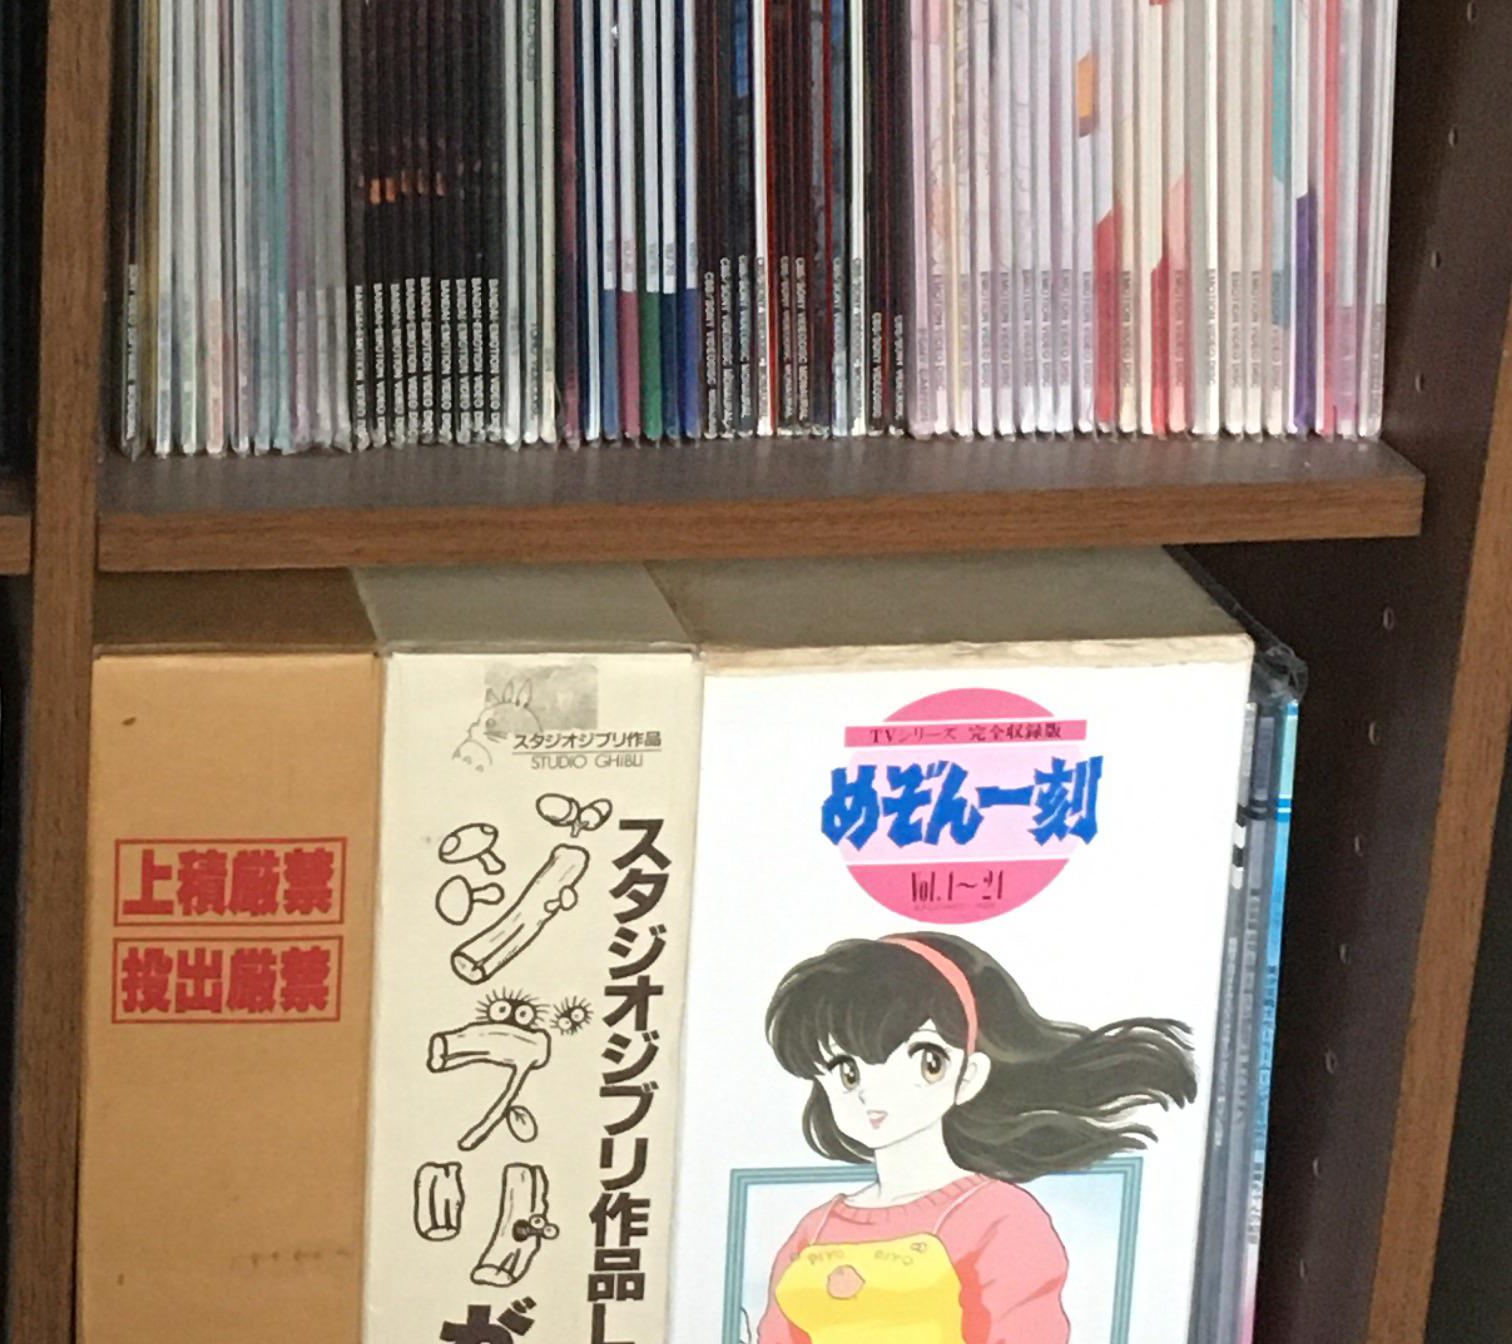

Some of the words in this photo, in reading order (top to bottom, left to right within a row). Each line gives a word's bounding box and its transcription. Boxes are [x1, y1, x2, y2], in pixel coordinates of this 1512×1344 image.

[1122, 271, 1132, 321] EMOTION
[1206, 269, 1216, 320] EMOTION
[934, 330, 944, 362] VIDEO
[1122, 327, 1132, 358] VIDEO
[1206, 324, 1216, 357] VIDEO
[1123, 363, 1132, 387] DISC
[1207, 361, 1216, 385] DISC
[512, 730, 662, 750] スタジオジブリ作品
[968, 722, 1062, 742] 完全収録版
[530, 753, 588, 770] STUDIO
[594, 752, 644, 769] GHIBLI
[821, 755, 1104, 851] めぞん一刻
[121, 848, 335, 917] 上積厳禁
